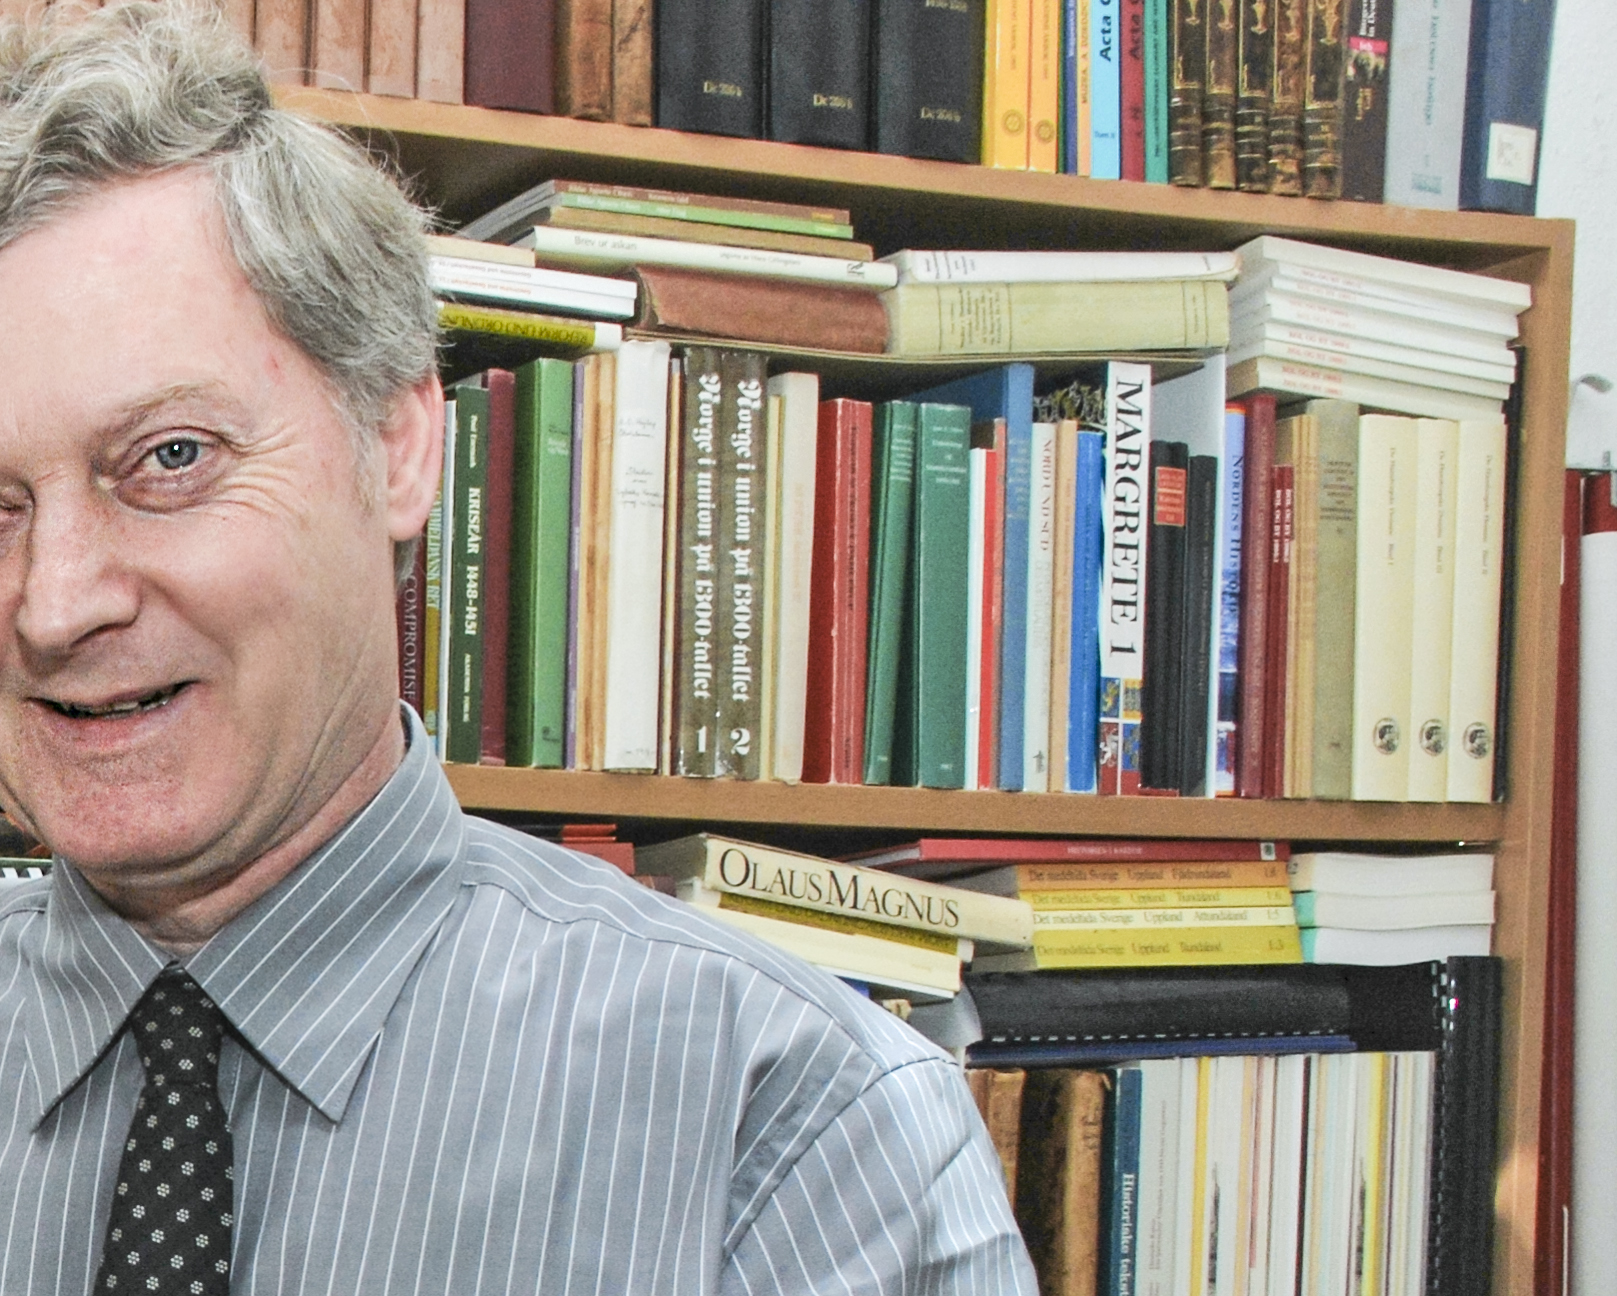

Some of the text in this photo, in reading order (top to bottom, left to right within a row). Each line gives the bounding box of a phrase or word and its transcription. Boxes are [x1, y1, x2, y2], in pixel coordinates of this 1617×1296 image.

[1097, 12, 1112, 63] Acta
[574, 235, 597, 249] Brev
[692, 375, 722, 454] Norge
[730, 380, 763, 458] Norge
[696, 455, 707, 466] i
[737, 464, 746, 474] i
[1041, 438, 1053, 481] NORD
[466, 486, 483, 556] KRISEÅR
[695, 467, 718, 538] union
[734, 475, 757, 543] union
[1108, 378, 1147, 627] MARGRETE
[689, 543, 713, 582] på
[728, 548, 752, 582] på
[464, 564, 479, 636] 1448-1451
[695, 729, 707, 753] 1
[730, 728, 750, 755] 2
[719, 848, 960, 929] OLAUS MAGNUS
[1033, 913, 1052, 925] Det
[1099, 911, 1134, 925] Sverige
[1143, 911, 1184, 925] Uppland
[1120, 1173, 1137, 1254] Historiske
